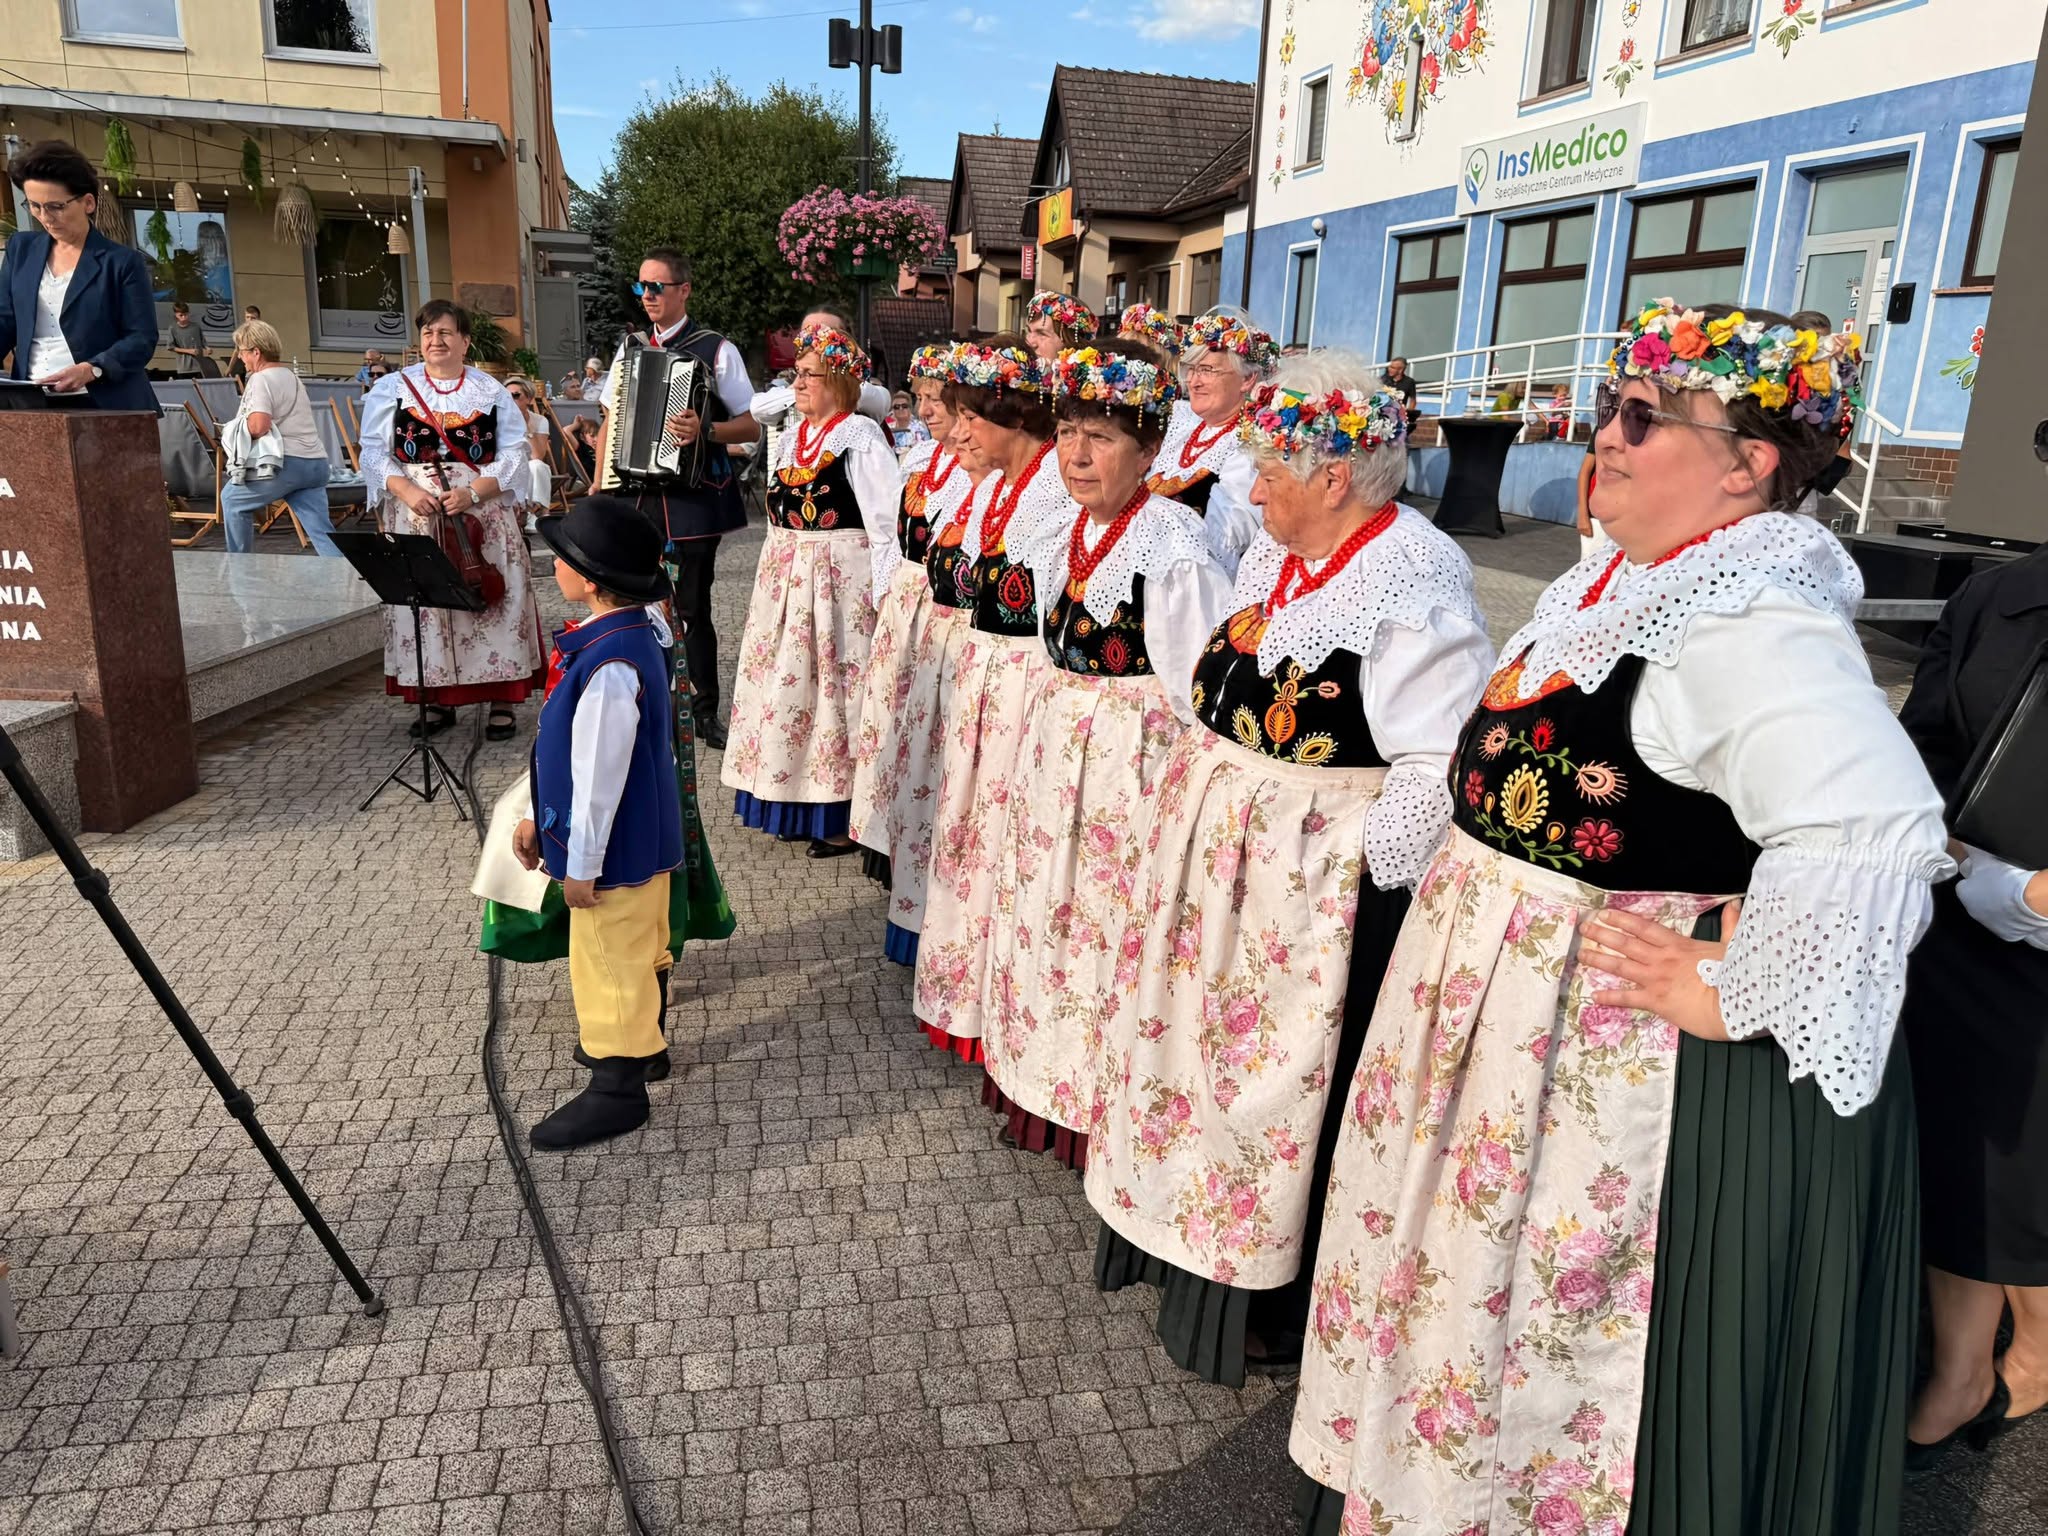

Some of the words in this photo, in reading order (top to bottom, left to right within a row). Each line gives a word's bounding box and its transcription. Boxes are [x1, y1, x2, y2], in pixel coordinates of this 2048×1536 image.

[1497, 122, 1628, 181] InsMedico
[1494, 180, 1548, 200] Specjalistyczne
[1549, 174, 1583, 189] Centrum
[1583, 165, 1624, 183] Medyczne
[0, 549, 34, 574] IA
